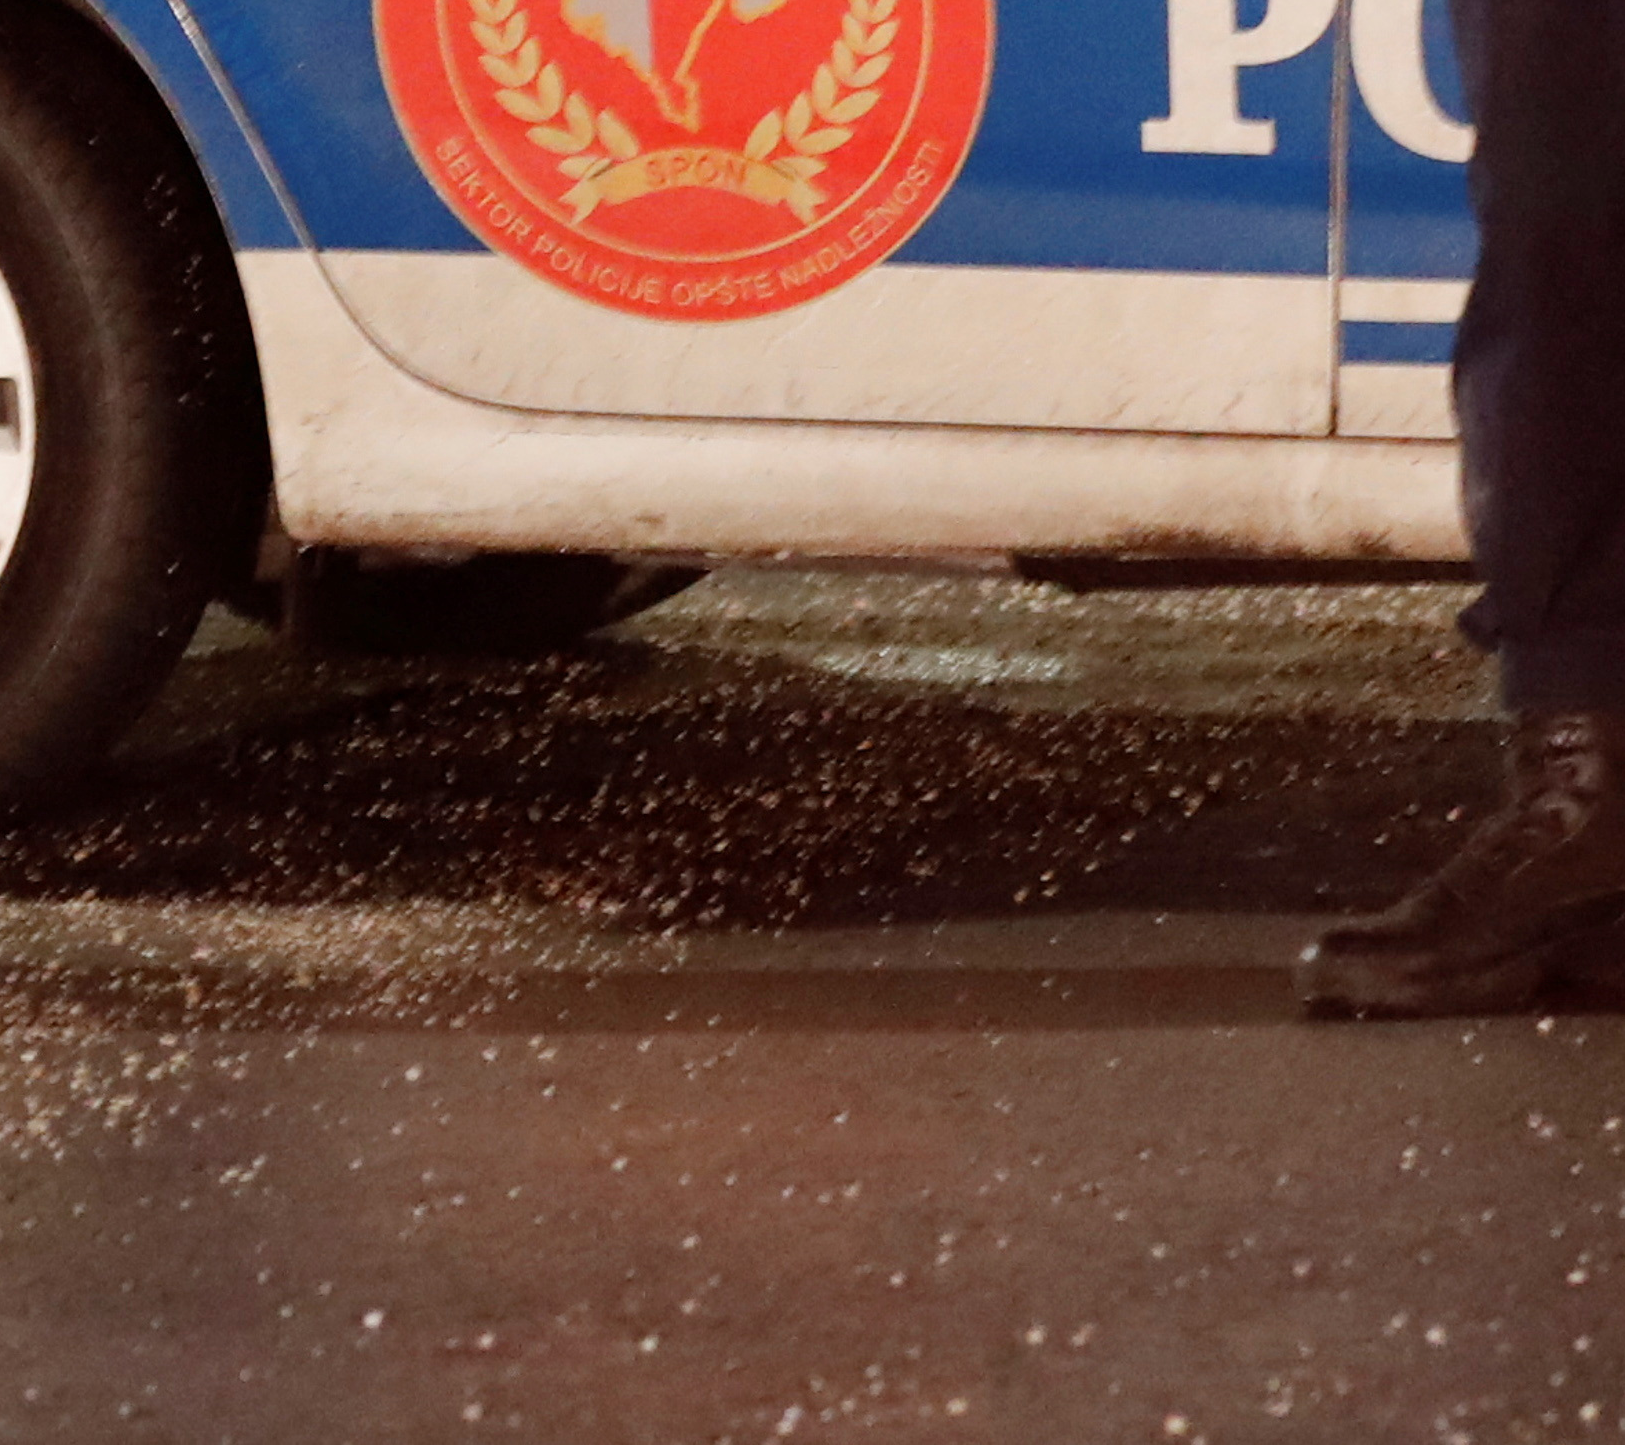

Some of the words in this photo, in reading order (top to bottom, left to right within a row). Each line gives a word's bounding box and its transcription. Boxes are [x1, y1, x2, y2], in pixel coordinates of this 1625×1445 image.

[434, 136, 534, 244] SEKTOR
[532, 230, 662, 305] POLICIJE
[645, 153, 749, 188] SPON
